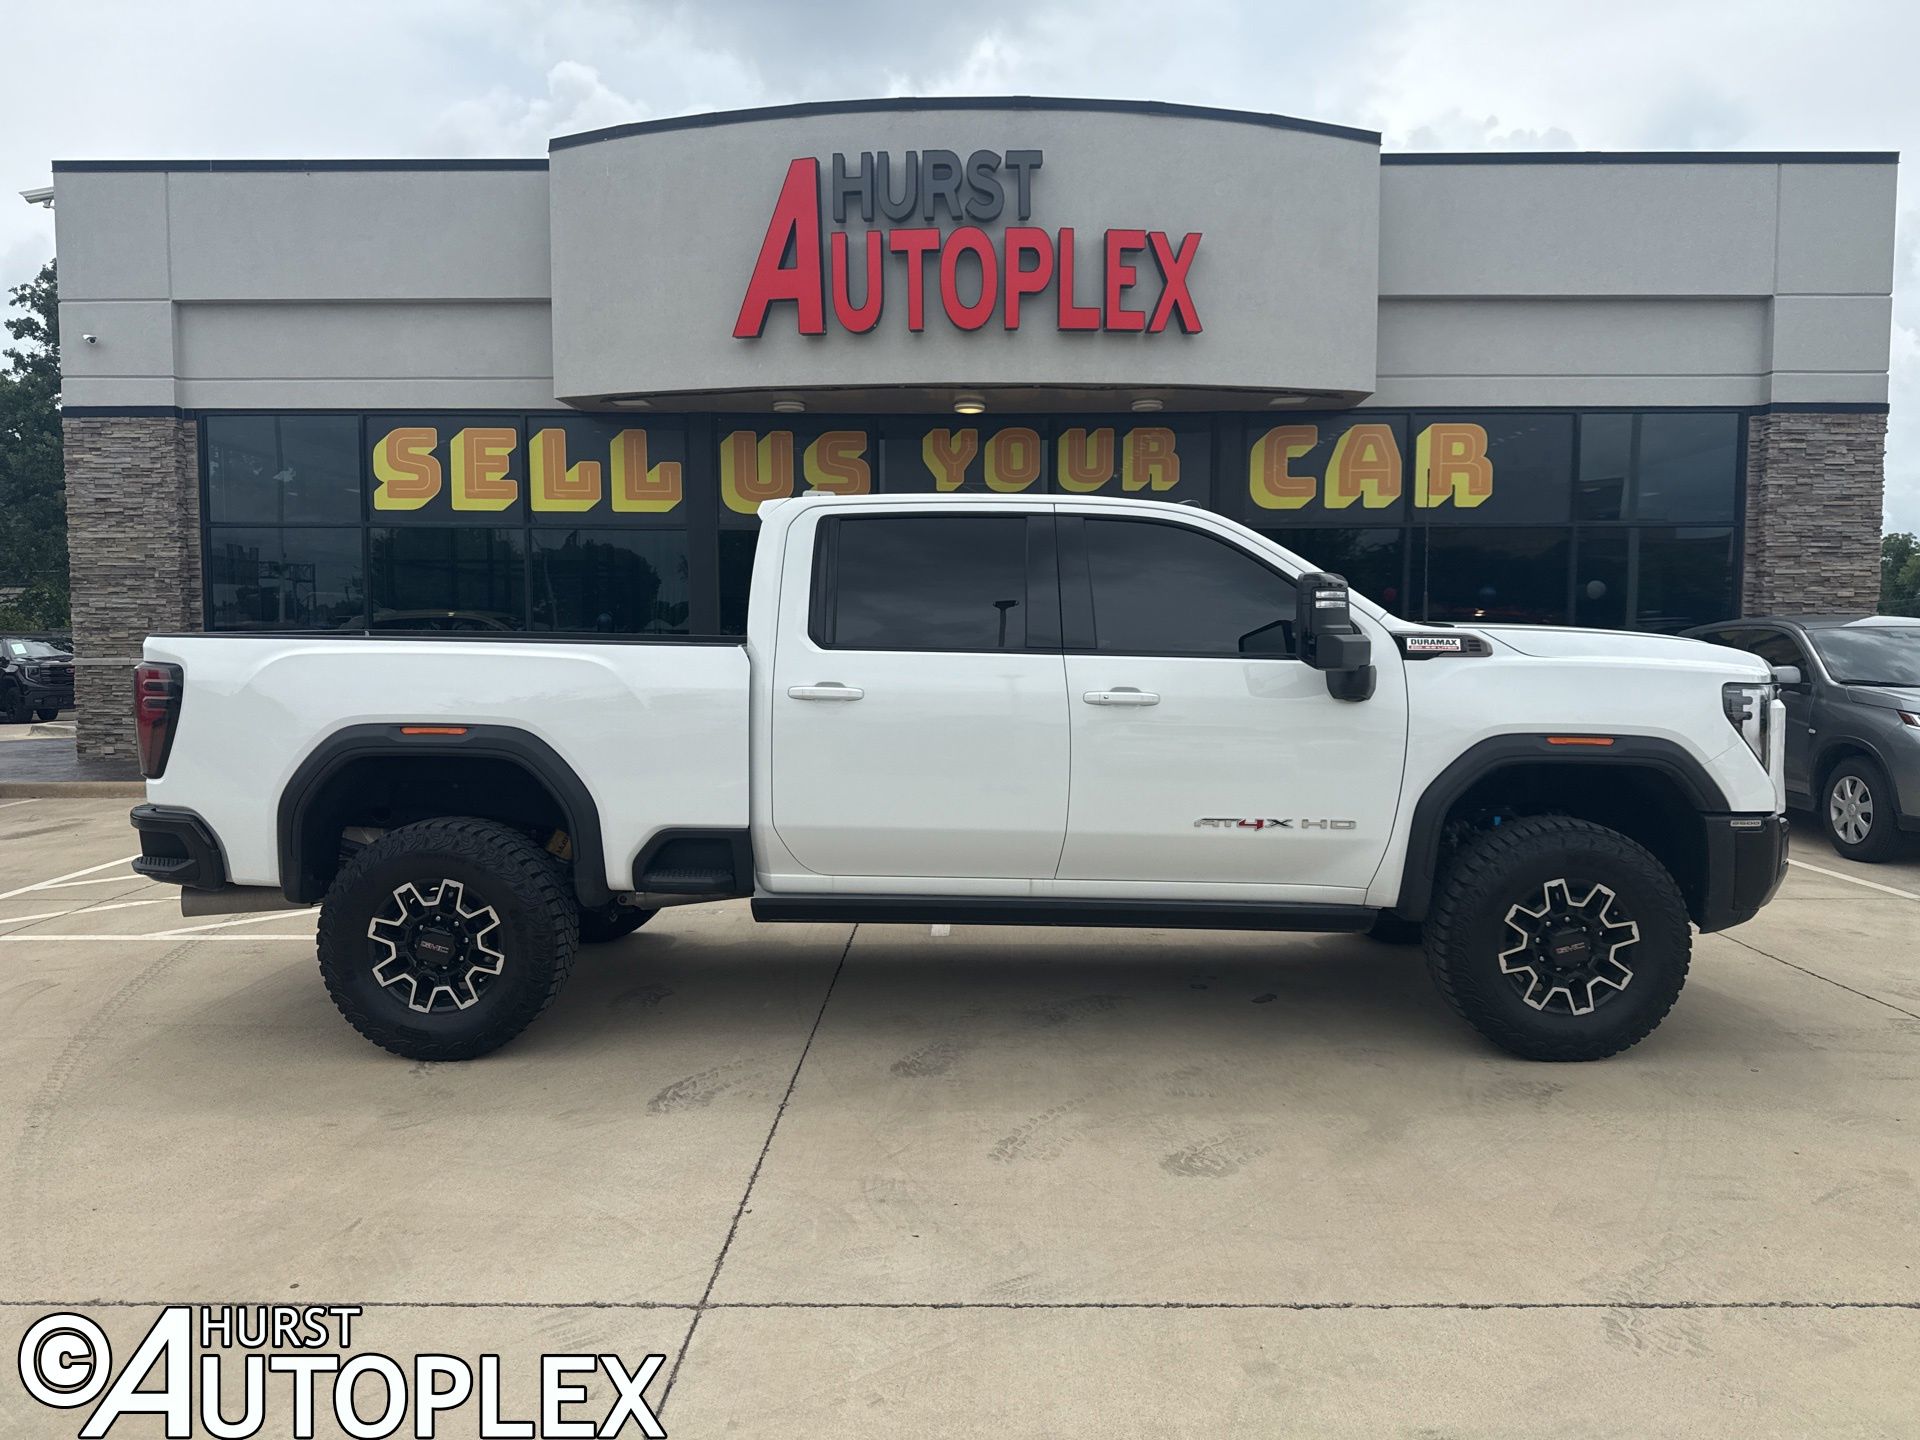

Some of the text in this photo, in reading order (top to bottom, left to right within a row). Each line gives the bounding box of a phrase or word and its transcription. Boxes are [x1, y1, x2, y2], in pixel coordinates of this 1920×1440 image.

[832, 149, 1043, 223] HURST
[732, 156, 1203, 338] AUTOPLEX
[373, 423, 1493, 514] SELL US YOUR CAR
[1410, 638, 1458, 646] DURAMAX
[1194, 818, 1357, 831] AT4X HD
